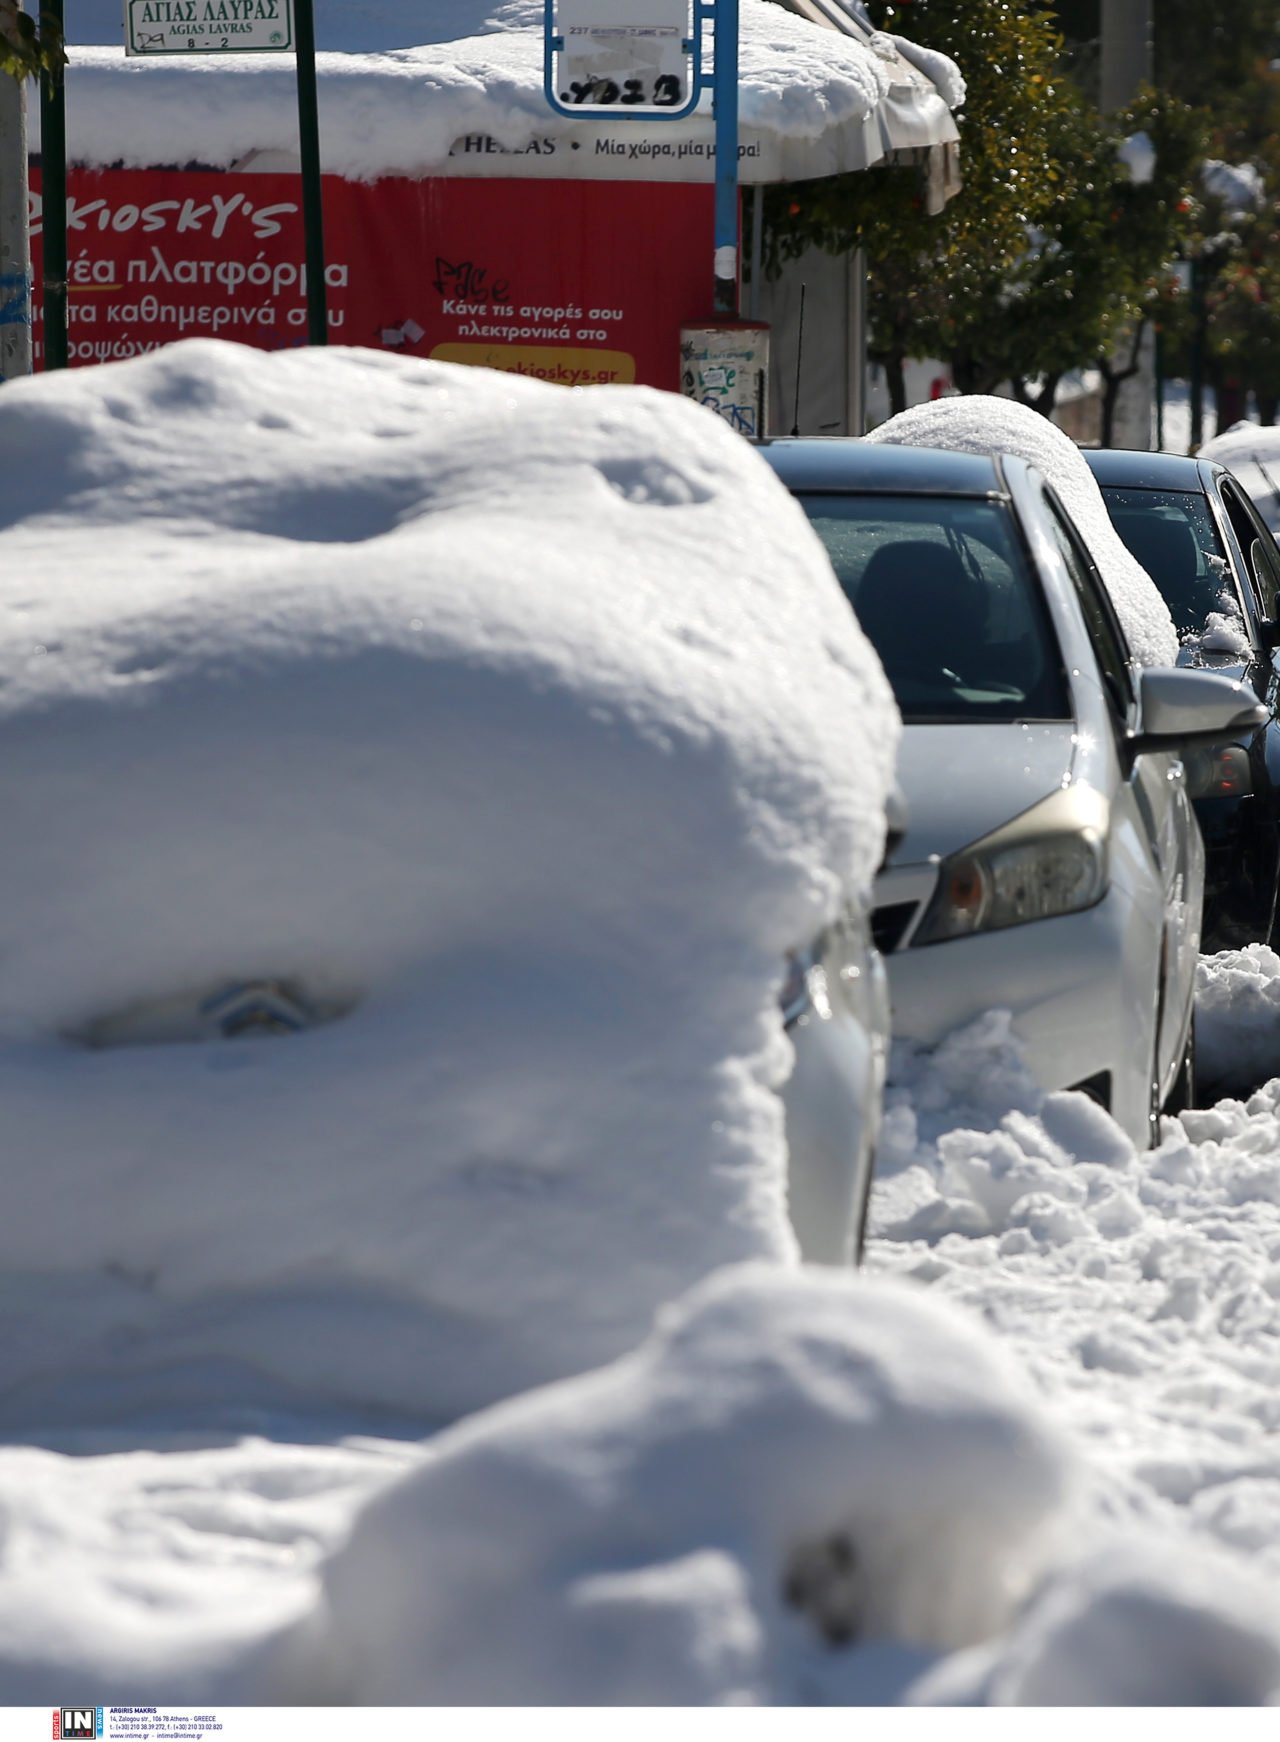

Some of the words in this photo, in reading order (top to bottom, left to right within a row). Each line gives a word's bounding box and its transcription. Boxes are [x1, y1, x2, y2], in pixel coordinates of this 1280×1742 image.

[142, 1, 197, 22] ΑΓΙΑΣ
[203, 0, 279, 21] ΛΑΥΡΑΣ
[169, 24, 205, 35] AGIAS
[209, 23, 253, 34] LAVRAS
[188, 39, 195, 48] 8
[221, 38, 229, 48] 2
[464, 136, 556, 155] HEAS
[595, 138, 626, 155] Μία
[628, 139, 675, 159] χώρα,
[678, 140, 704, 158] μία
[707, 141, 761, 160] μρα!
[67, 248, 115, 283] έα
[107, 295, 276, 332] καθημερινά
[287, 308, 344, 327] συ
[442, 299, 487, 316] Κάνε
[492, 302, 514, 317] τις
[519, 304, 583, 322] αγορές
[588, 308, 623, 320] σου
[458, 320, 571, 342] ηλεκτρονικά
[576, 326, 607, 340] στο
